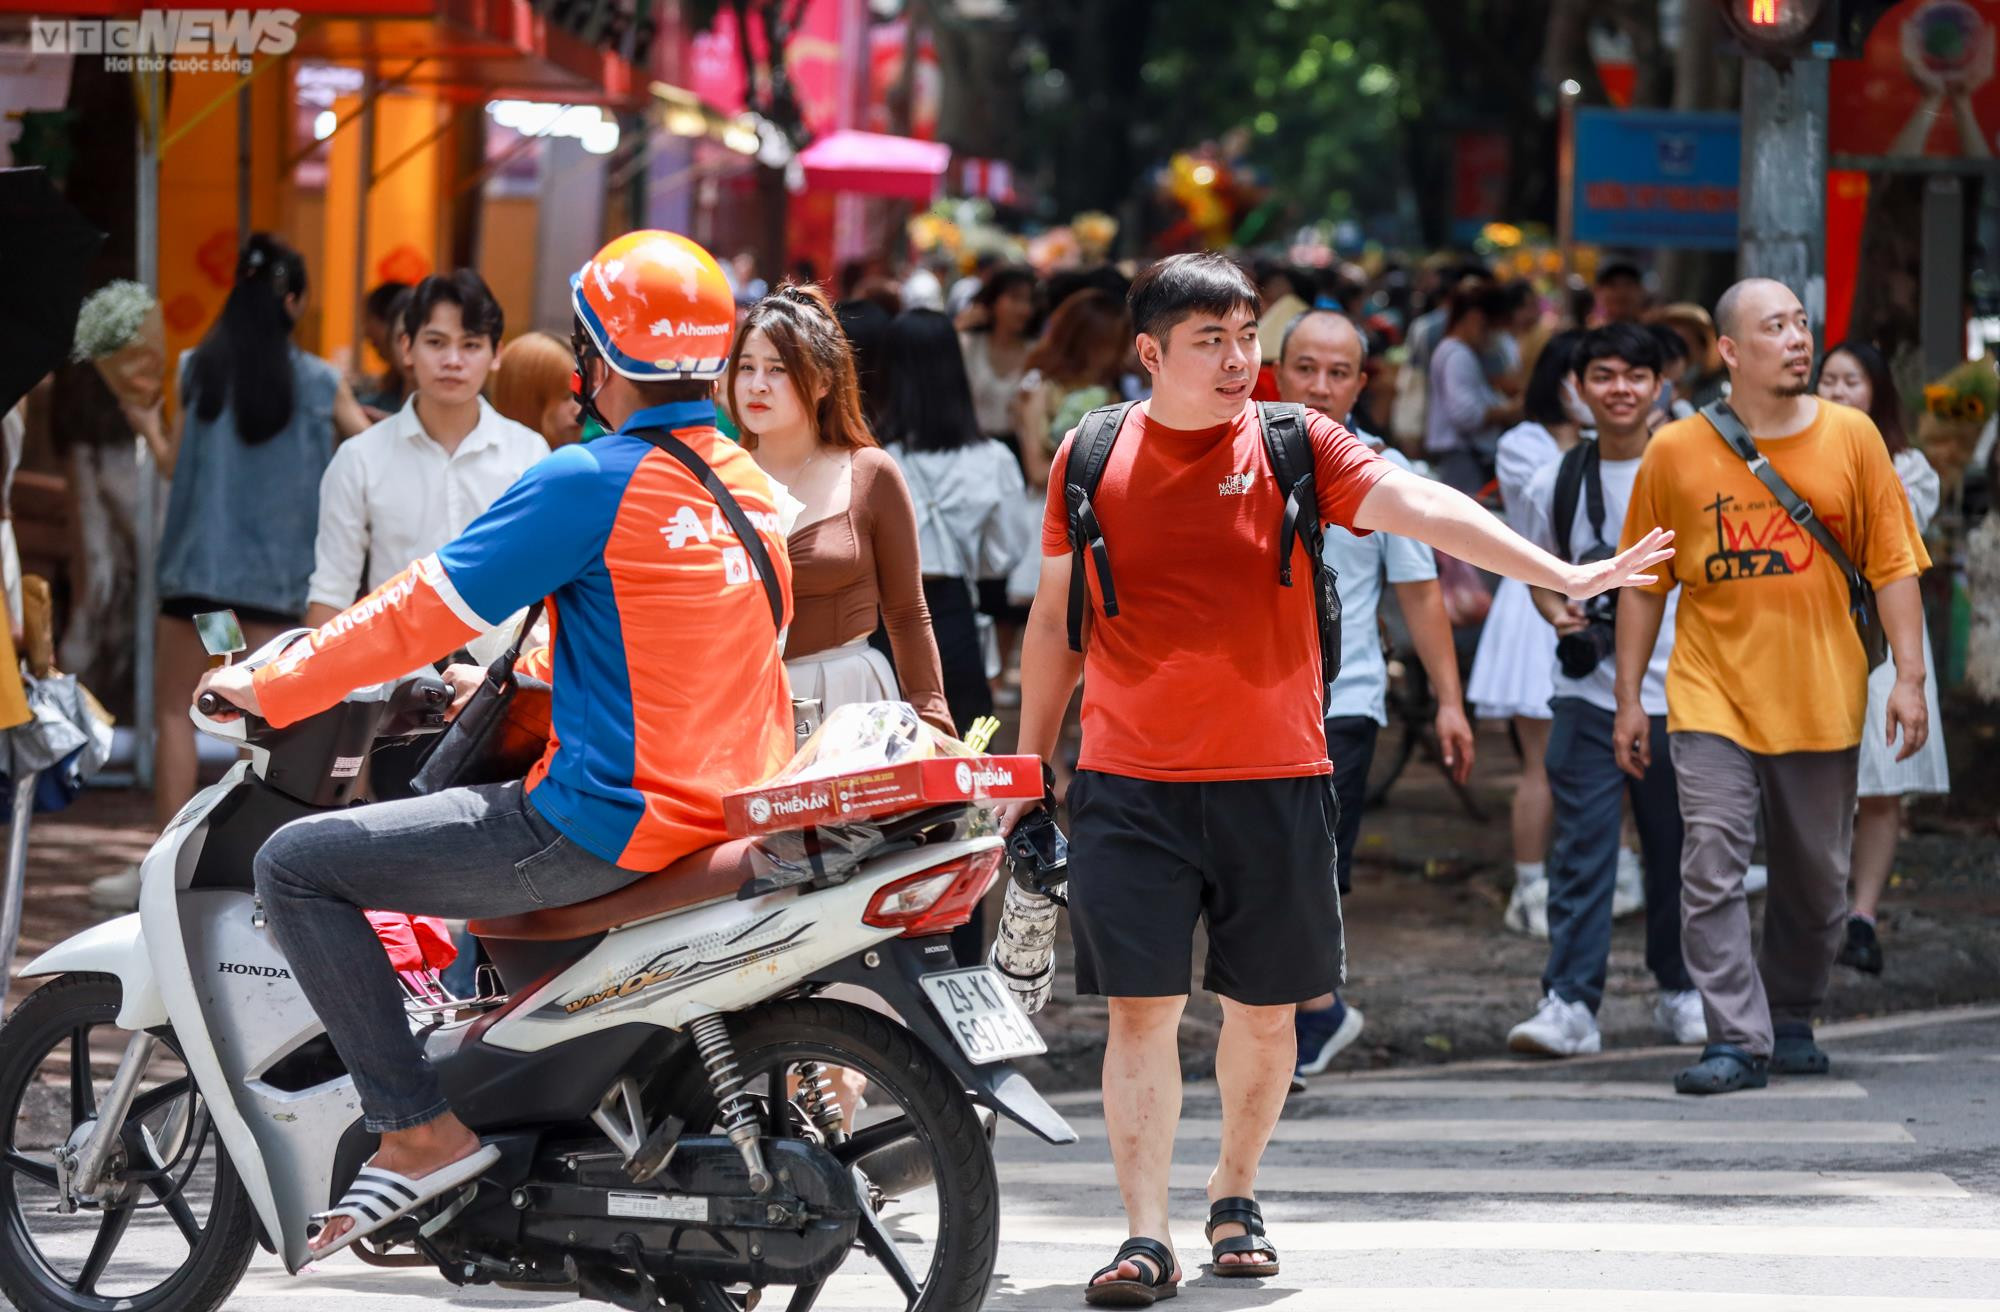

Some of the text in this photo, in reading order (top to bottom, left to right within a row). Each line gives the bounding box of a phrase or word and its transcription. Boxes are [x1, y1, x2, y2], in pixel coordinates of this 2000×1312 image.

[1219, 488, 1243, 496] FACE
[1709, 553, 1772, 580] 91.7
[925, 944, 949, 954] HONDA
[217, 962, 292, 980] HONDA
[564, 984, 620, 1014] WAVE
[937, 975, 1005, 1014] 29-K1
